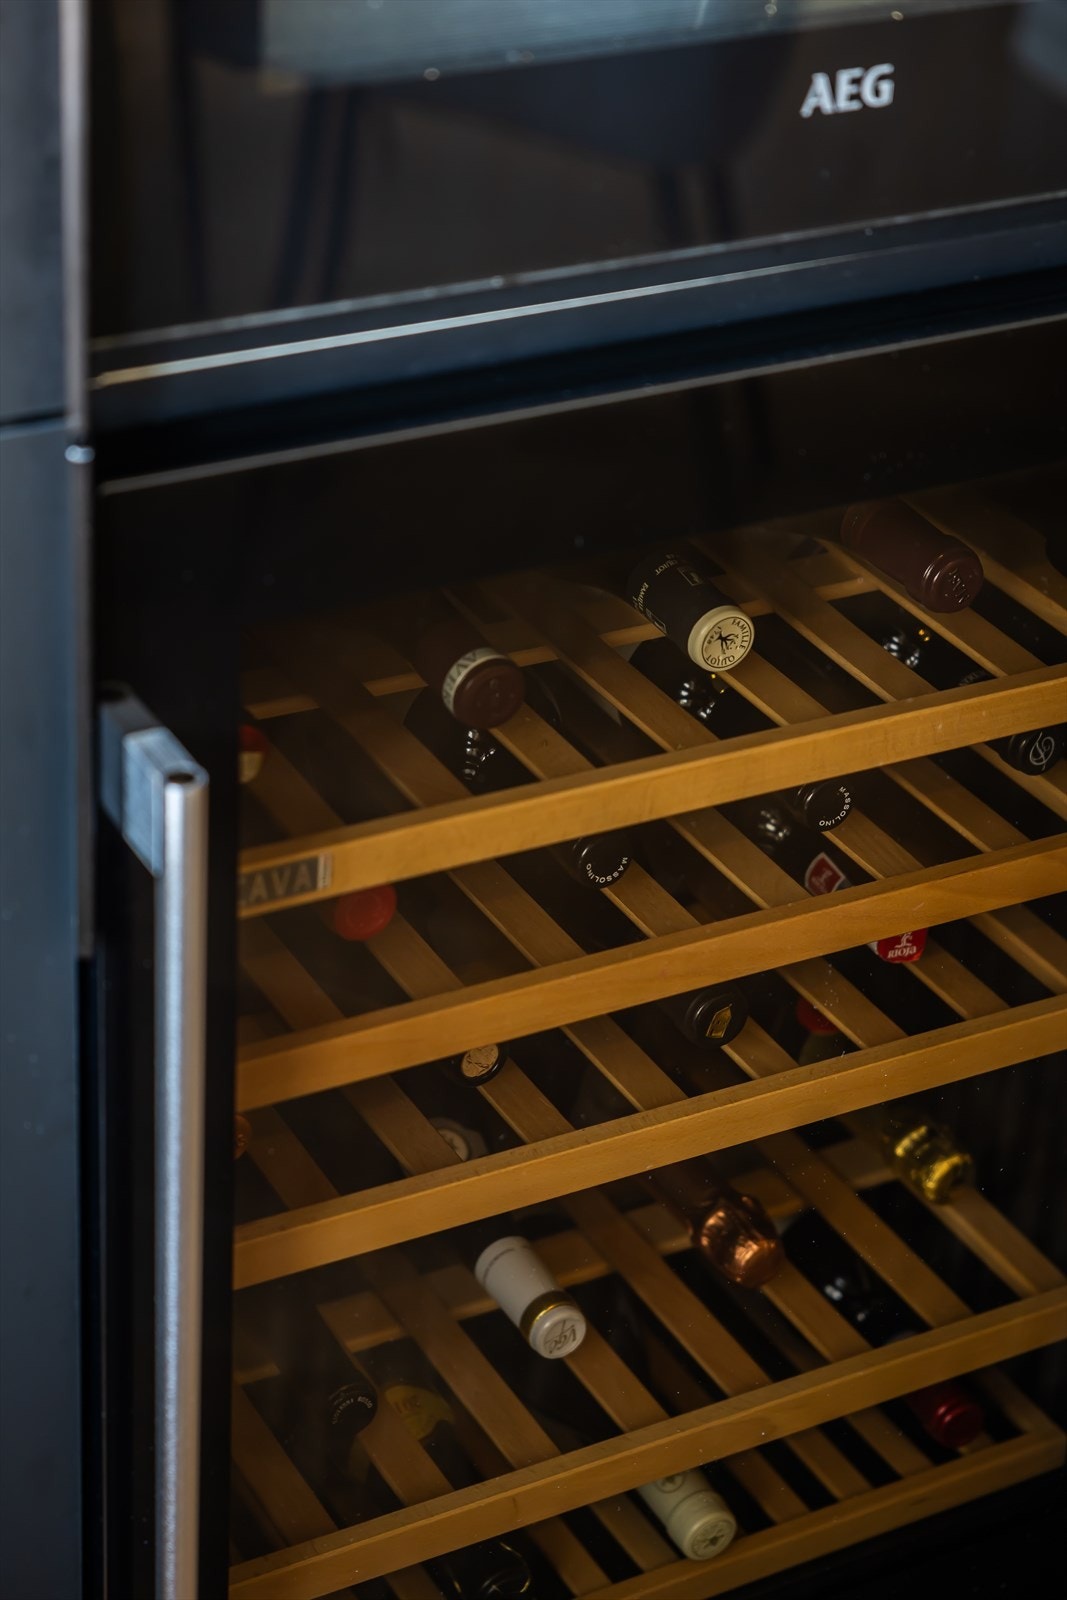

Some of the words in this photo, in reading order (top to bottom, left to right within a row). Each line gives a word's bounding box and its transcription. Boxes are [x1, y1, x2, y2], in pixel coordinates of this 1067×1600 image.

[799, 63, 894, 118] AEG
[731, 618, 749, 650] FAMILLE
[706, 654, 735, 666] QUIOT
[818, 786, 852, 827] MASSOLINO
[586, 857, 629, 884] MASSOLINO
